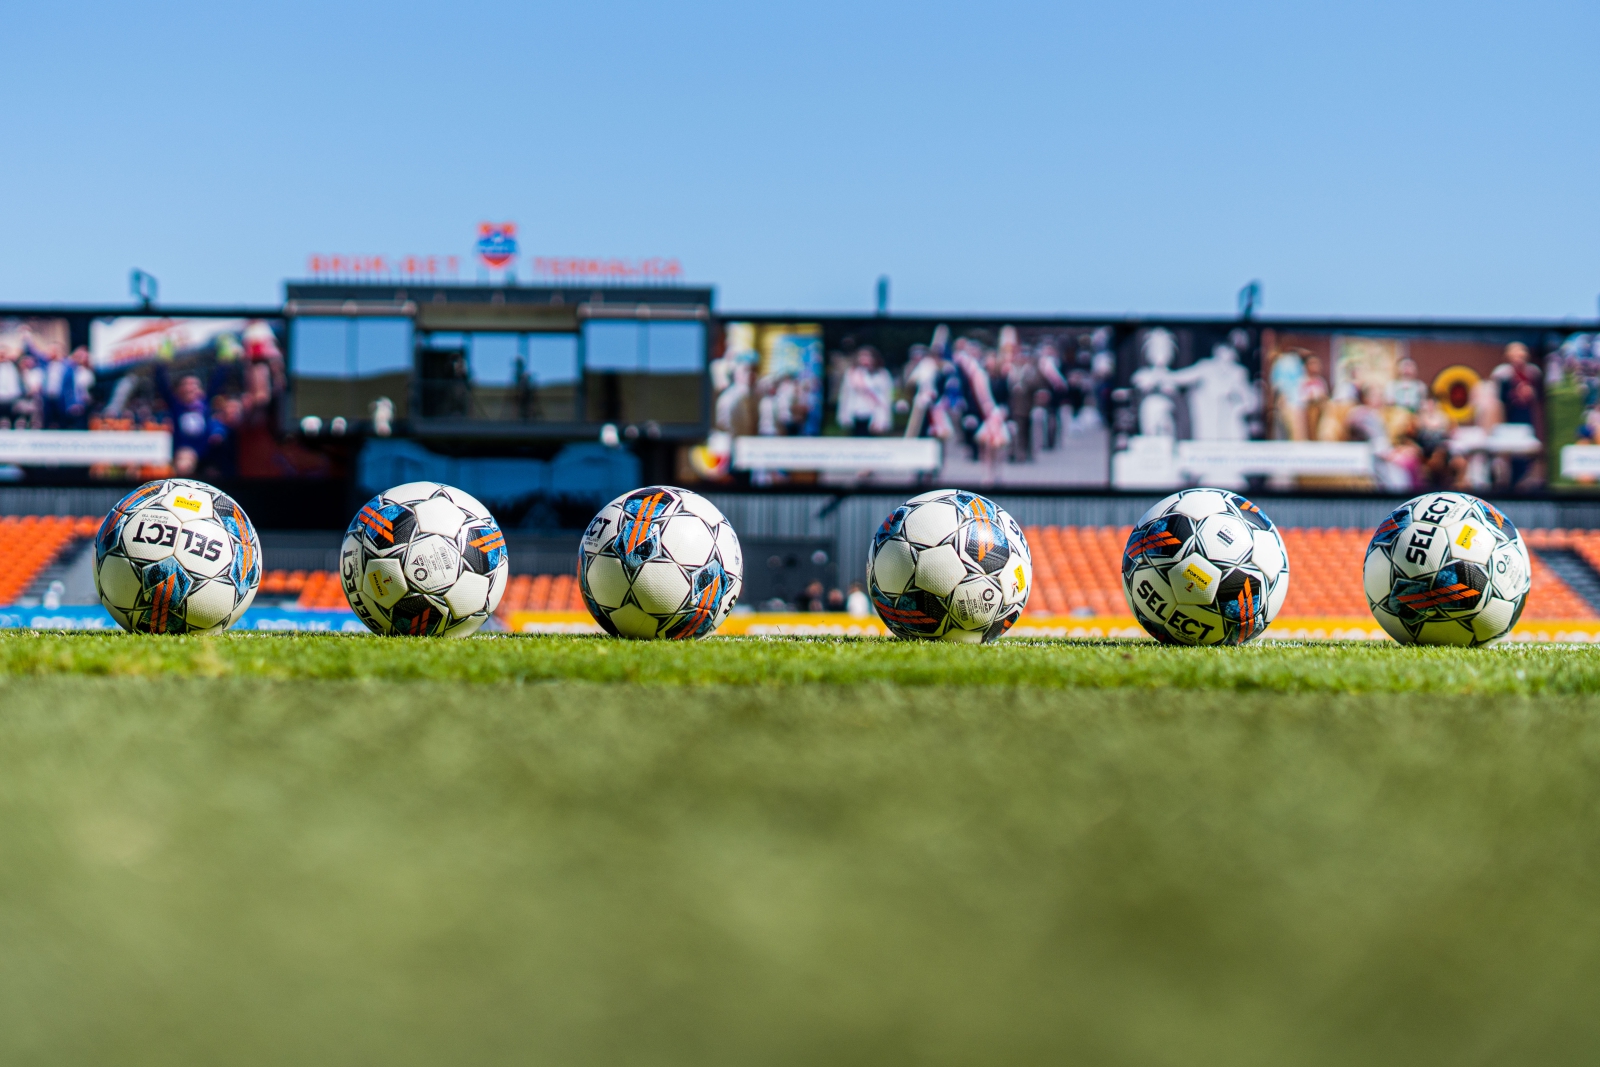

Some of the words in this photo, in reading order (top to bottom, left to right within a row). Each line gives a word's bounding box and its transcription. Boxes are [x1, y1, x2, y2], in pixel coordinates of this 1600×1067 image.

[132, 521, 223, 562] SELECT
[1405, 497, 1456, 566] SELECT
[343, 550, 383, 630] SELECT
[372, 573, 384, 596] FORTUNA
[1186, 568, 1208, 586] FORTUNA
[1137, 580, 1215, 640] SELECT
